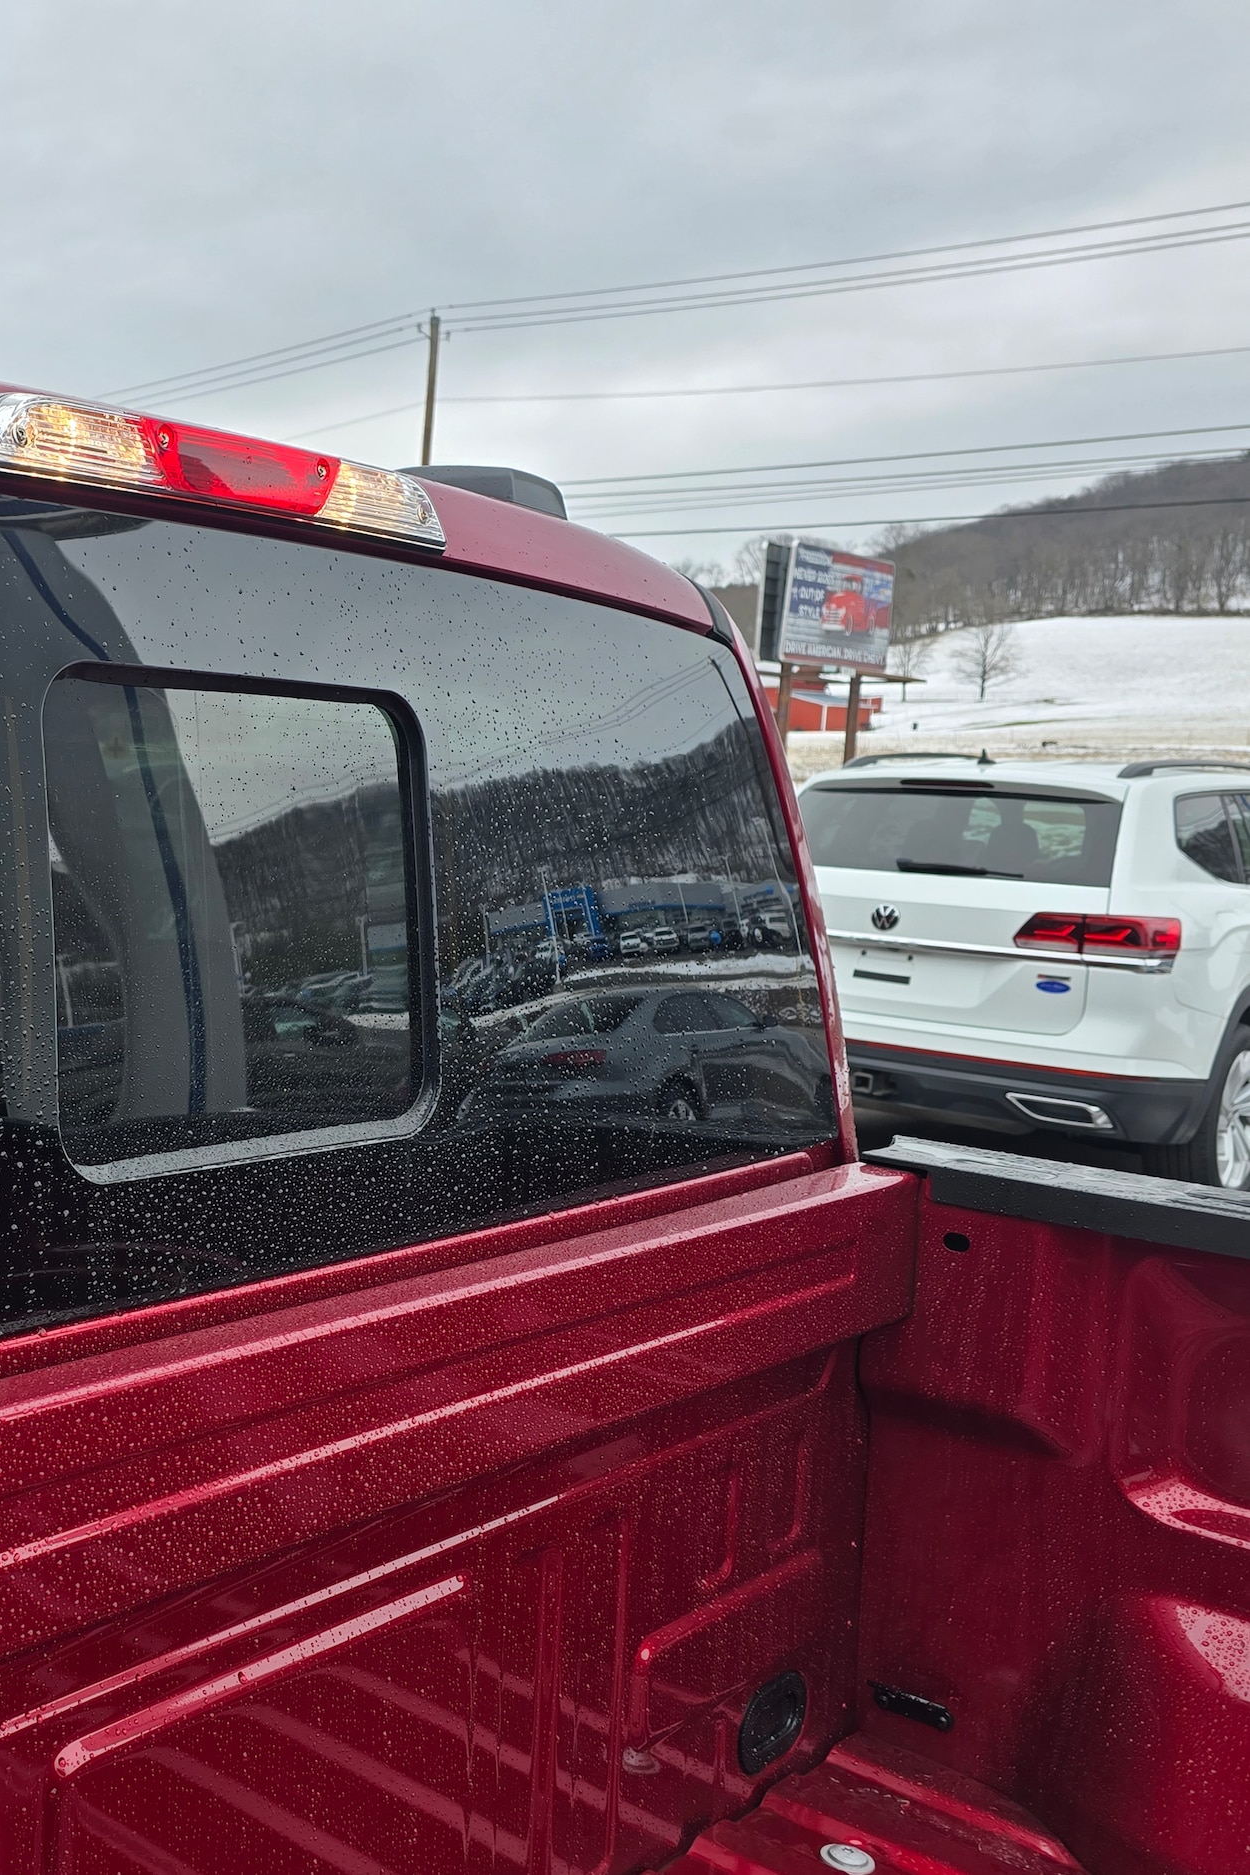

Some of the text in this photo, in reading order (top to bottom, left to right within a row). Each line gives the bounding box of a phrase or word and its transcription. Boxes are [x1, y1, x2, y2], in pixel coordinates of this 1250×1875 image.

[798, 604, 820, 619] STYLE
[785, 640, 806, 654] DRIVE
[844, 647, 862, 662] DRIVE
